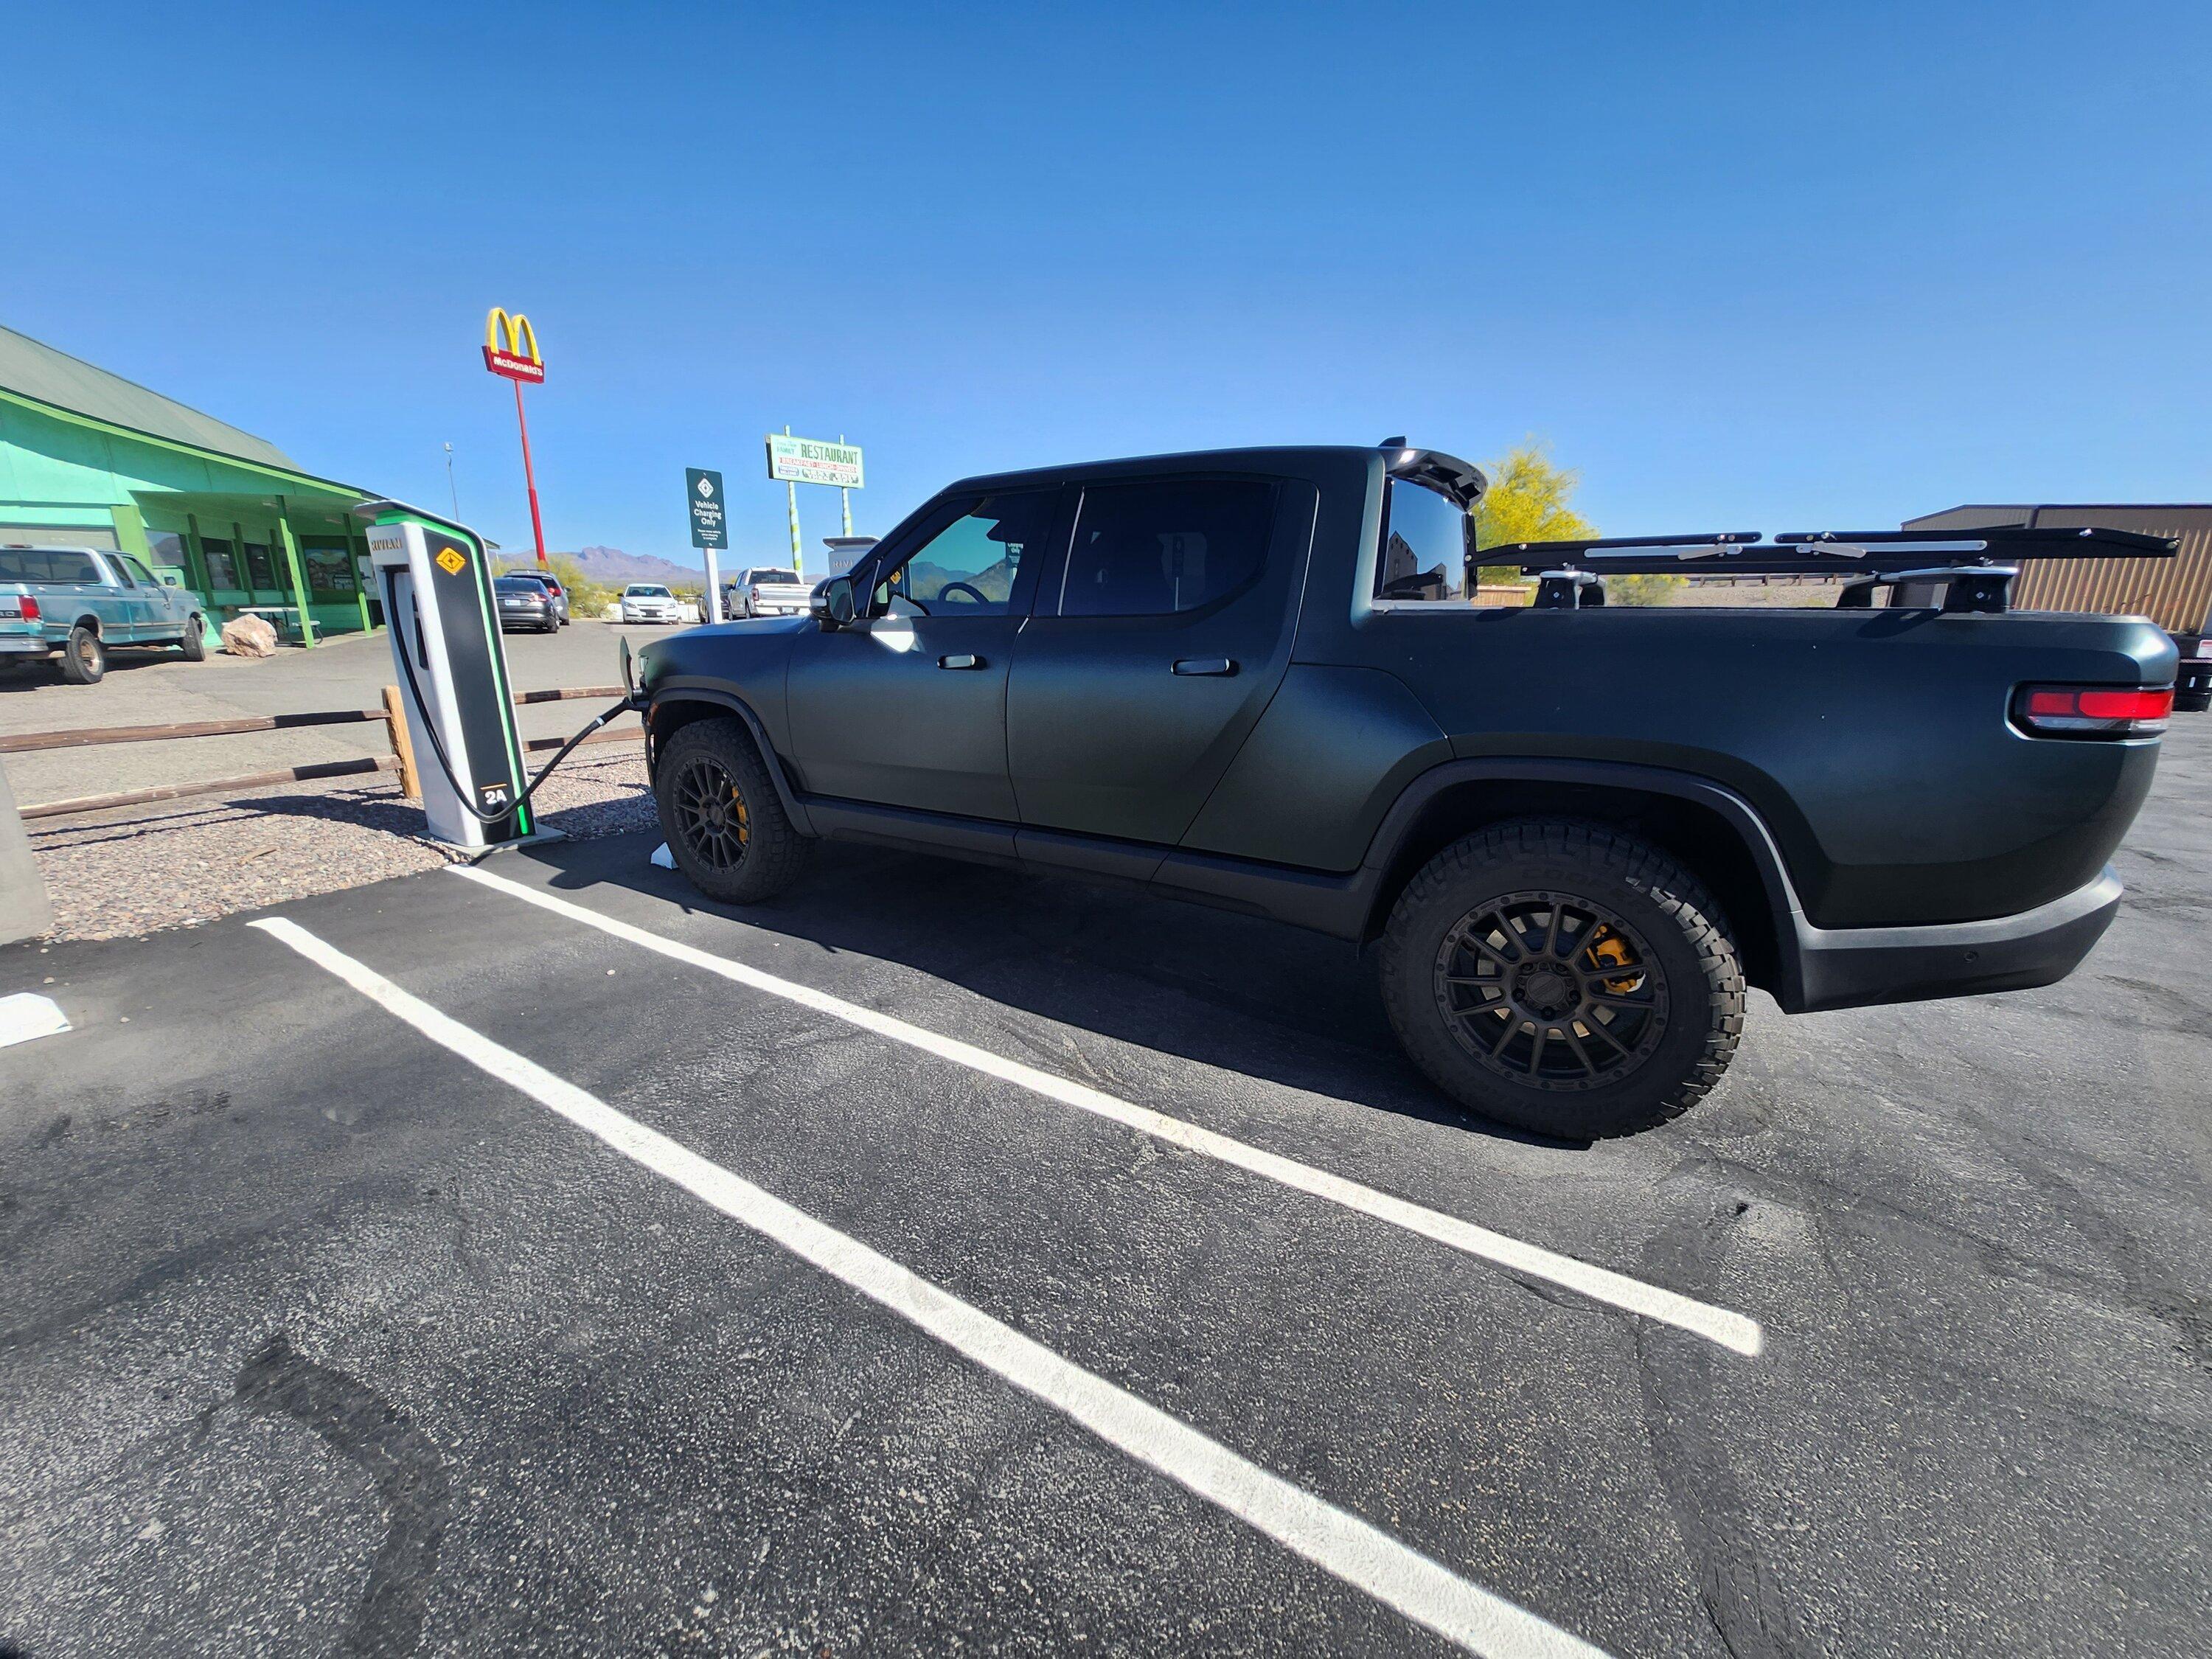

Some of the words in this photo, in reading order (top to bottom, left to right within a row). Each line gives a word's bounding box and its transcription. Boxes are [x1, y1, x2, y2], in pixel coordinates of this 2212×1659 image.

[493, 356, 543, 376] McDonald's
[801, 443, 858, 465] RESTAURANT
[695, 501, 719, 509] Vehicle
[694, 509, 722, 520] Charging
[701, 518, 716, 526] Only
[371, 538, 403, 551] RIVIAN
[484, 789, 507, 805] 2A
